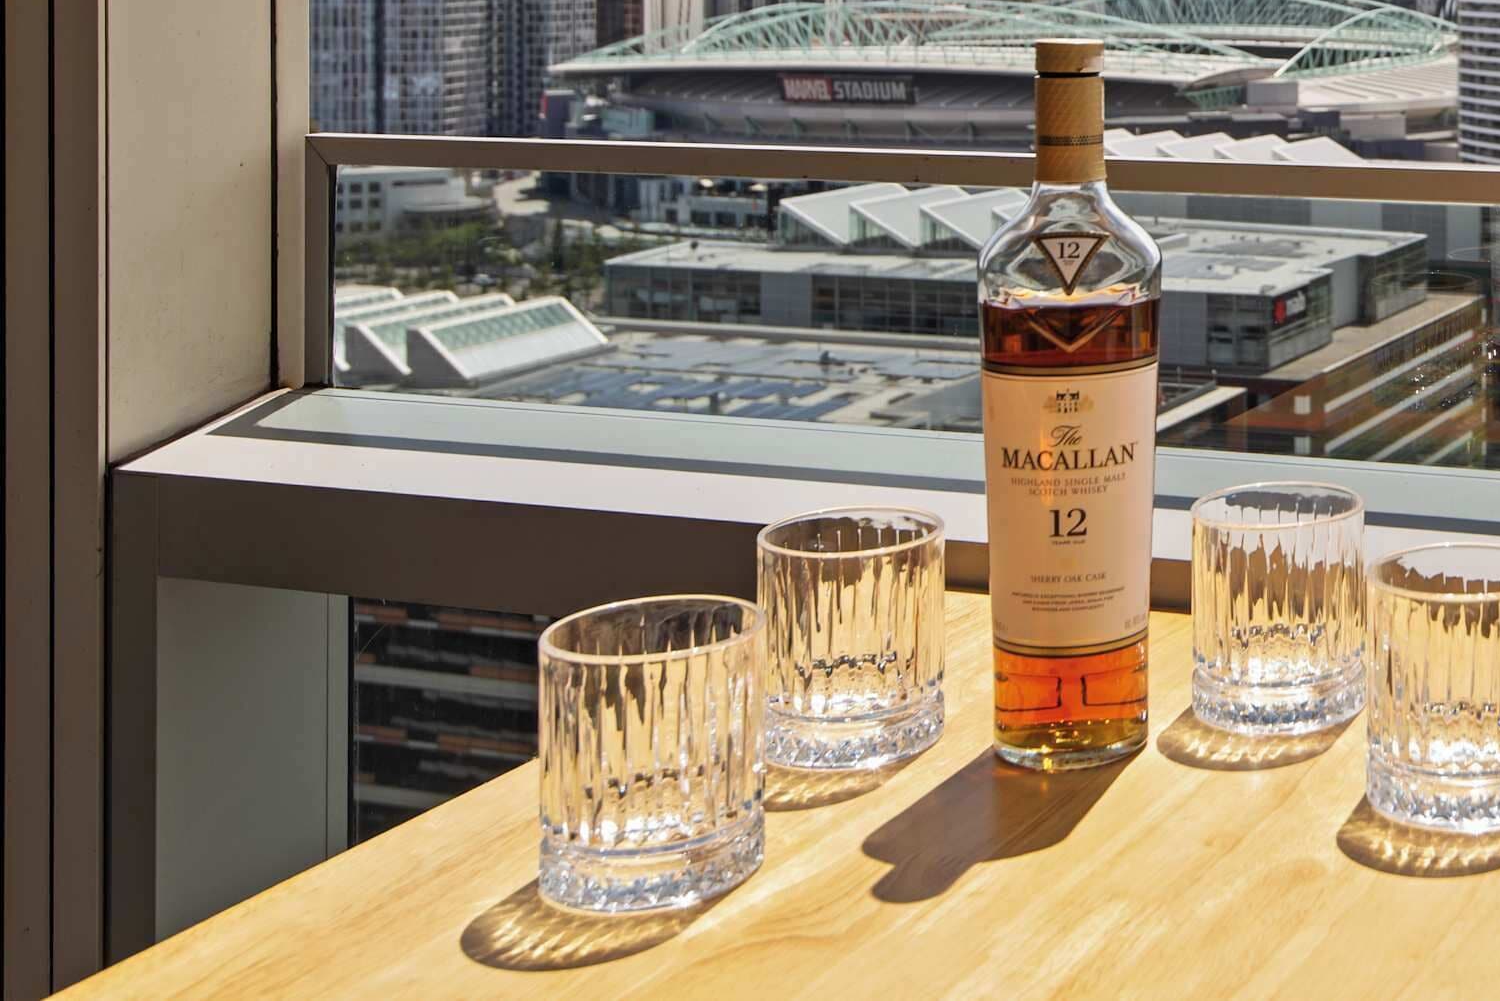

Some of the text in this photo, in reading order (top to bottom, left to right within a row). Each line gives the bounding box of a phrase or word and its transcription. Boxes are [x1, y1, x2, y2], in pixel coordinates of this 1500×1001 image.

[783, 78, 907, 101] MARVEL STADIUM
[1056, 241, 1081, 260] 12
[1049, 424, 1082, 447] The
[1001, 443, 1135, 471] MACALLAN
[1011, 472, 1126, 487] HIGHLAND SINGLE MALT
[1029, 485, 1108, 496] SCOTCH WHISKY
[1049, 508, 1087, 537] 12
[1063, 573, 1082, 583] OAK
